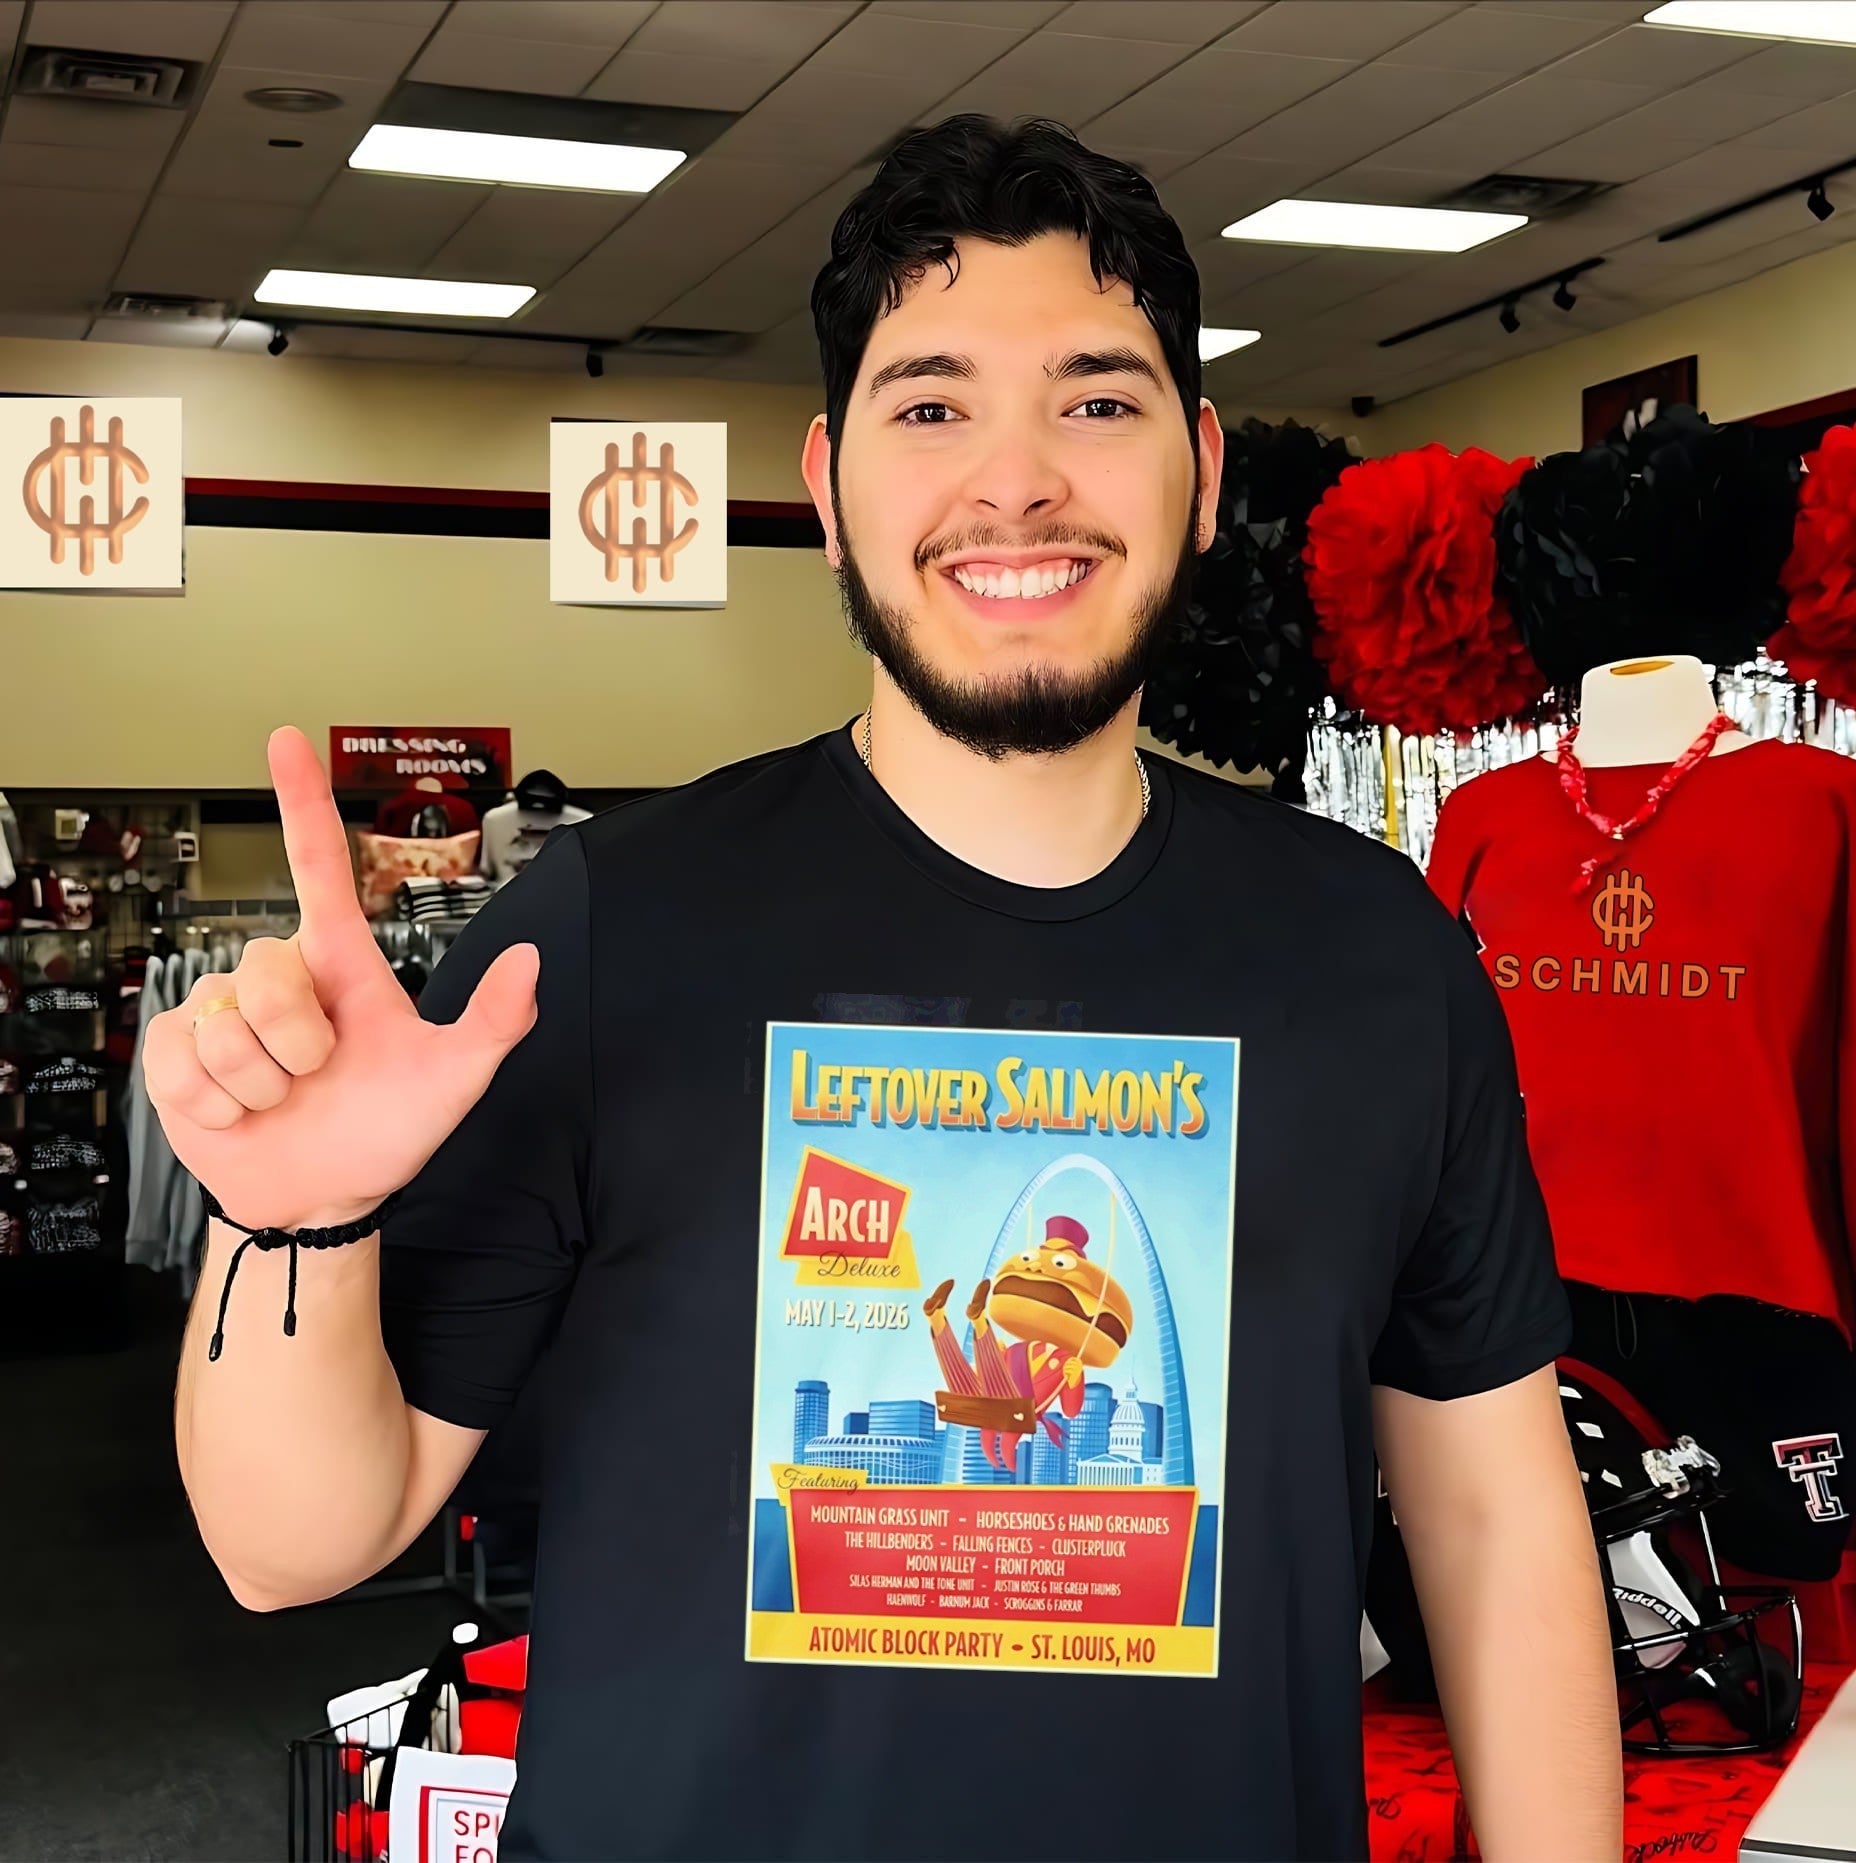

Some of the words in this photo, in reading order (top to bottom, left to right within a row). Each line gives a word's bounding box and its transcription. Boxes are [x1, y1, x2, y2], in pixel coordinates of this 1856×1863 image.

[342, 737, 467, 754] DRESSING
[396, 758, 487, 775] ROOMS
[1493, 954, 1747, 1001] SCHMIDT
[790, 1049, 992, 1133] LEFTOVER
[994, 1056, 1210, 1139] SALMON'S
[799, 1186, 890, 1243] ARCH
[817, 1250, 901, 1277] Deluxe
[785, 1298, 826, 1327] MAY
[829, 1299, 861, 1334] 1-2,
[863, 1301, 910, 1330] 2026
[777, 1467, 860, 1495] Featuring
[811, 1505, 876, 1525] MOUNTAIN
[878, 1507, 917, 1526] GRASS
[919, 1509, 950, 1527] UNIT
[976, 1511, 1055, 1531] HORSESHOES
[1068, 1514, 1103, 1533] HAND
[1105, 1515, 1170, 1535] GRENADES
[844, 1531, 864, 1548] THE
[866, 1532, 934, 1550] HILLBENDERS
[953, 1535, 994, 1553] FALLING
[996, 1536, 1033, 1554] FENCES
[1051, 1538, 1126, 1557] CLUSTERPLUCK
[906, 1554, 938, 1572] MOON
[939, 1556, 976, 1574] VALLEY
[994, 1557, 1029, 1575] FRONT
[1029, 1559, 1065, 1577] PORCH
[849, 1574, 870, 1588] SILAS
[871, 1575, 903, 1589] HERMAN
[903, 1576, 920, 1589] AND
[921, 1577, 935, 1590] THE
[937, 1577, 955, 1591] TONE
[957, 1579, 975, 1592] UNIT
[994, 1580, 1020, 1593] JUSTIN
[1020, 1580, 1040, 1594] ROSE
[1049, 1581, 1063, 1595] THE
[1063, 1582, 1088, 1595] GREEN
[1090, 1583, 1121, 1597] THUMBS
[972, 1596, 990, 1609] JACK
[809, 1626, 878, 1655] ATOMIC
[881, 1629, 940, 1656] BLOCK
[945, 1631, 1003, 1658] PARTY
[1031, 1634, 1058, 1661] ST.
[1062, 1635, 1122, 1667] LOUIS,
[1126, 1637, 1156, 1663] MO
